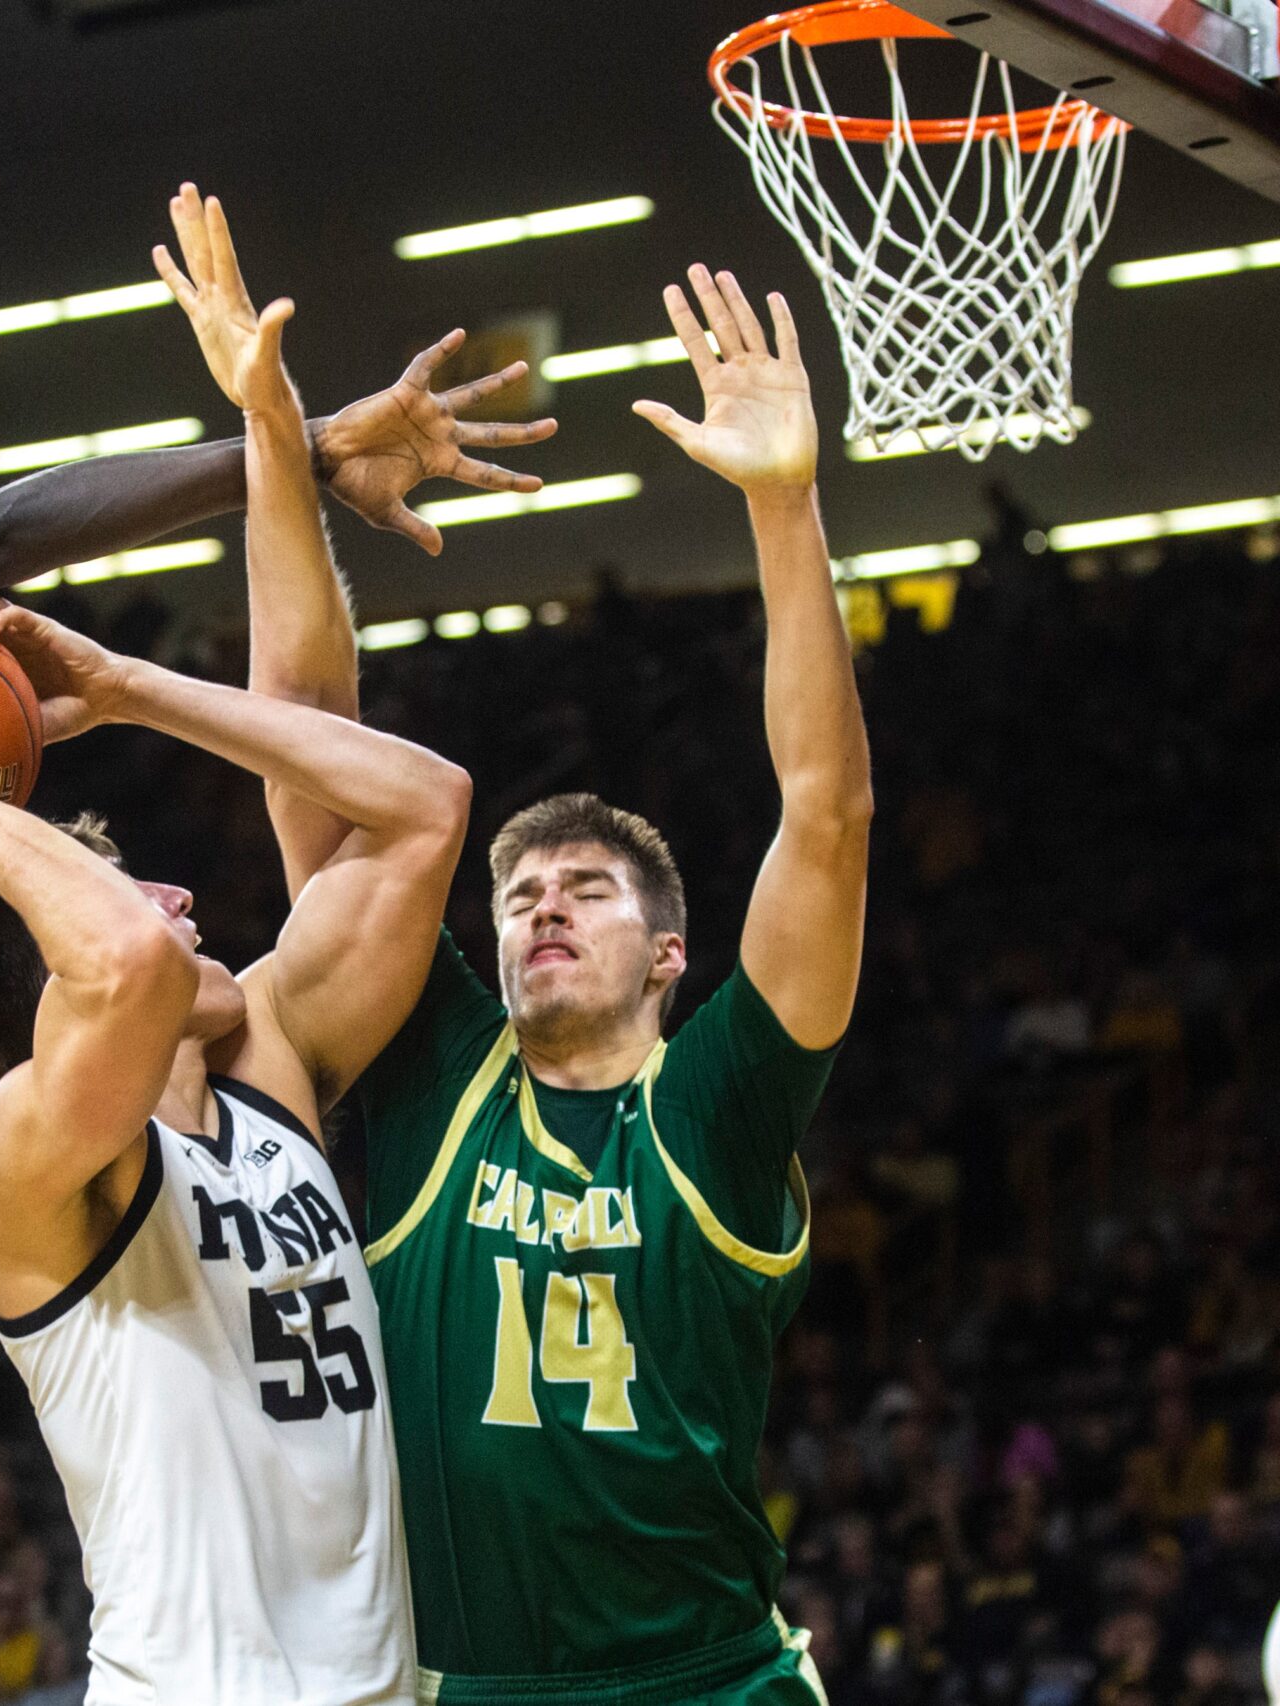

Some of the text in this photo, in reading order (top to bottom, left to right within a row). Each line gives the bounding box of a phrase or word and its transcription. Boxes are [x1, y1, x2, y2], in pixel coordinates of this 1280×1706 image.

[466, 1159, 540, 1246] CAL
[249, 1277, 376, 1422] 55
[481, 1256, 639, 1432] 14
